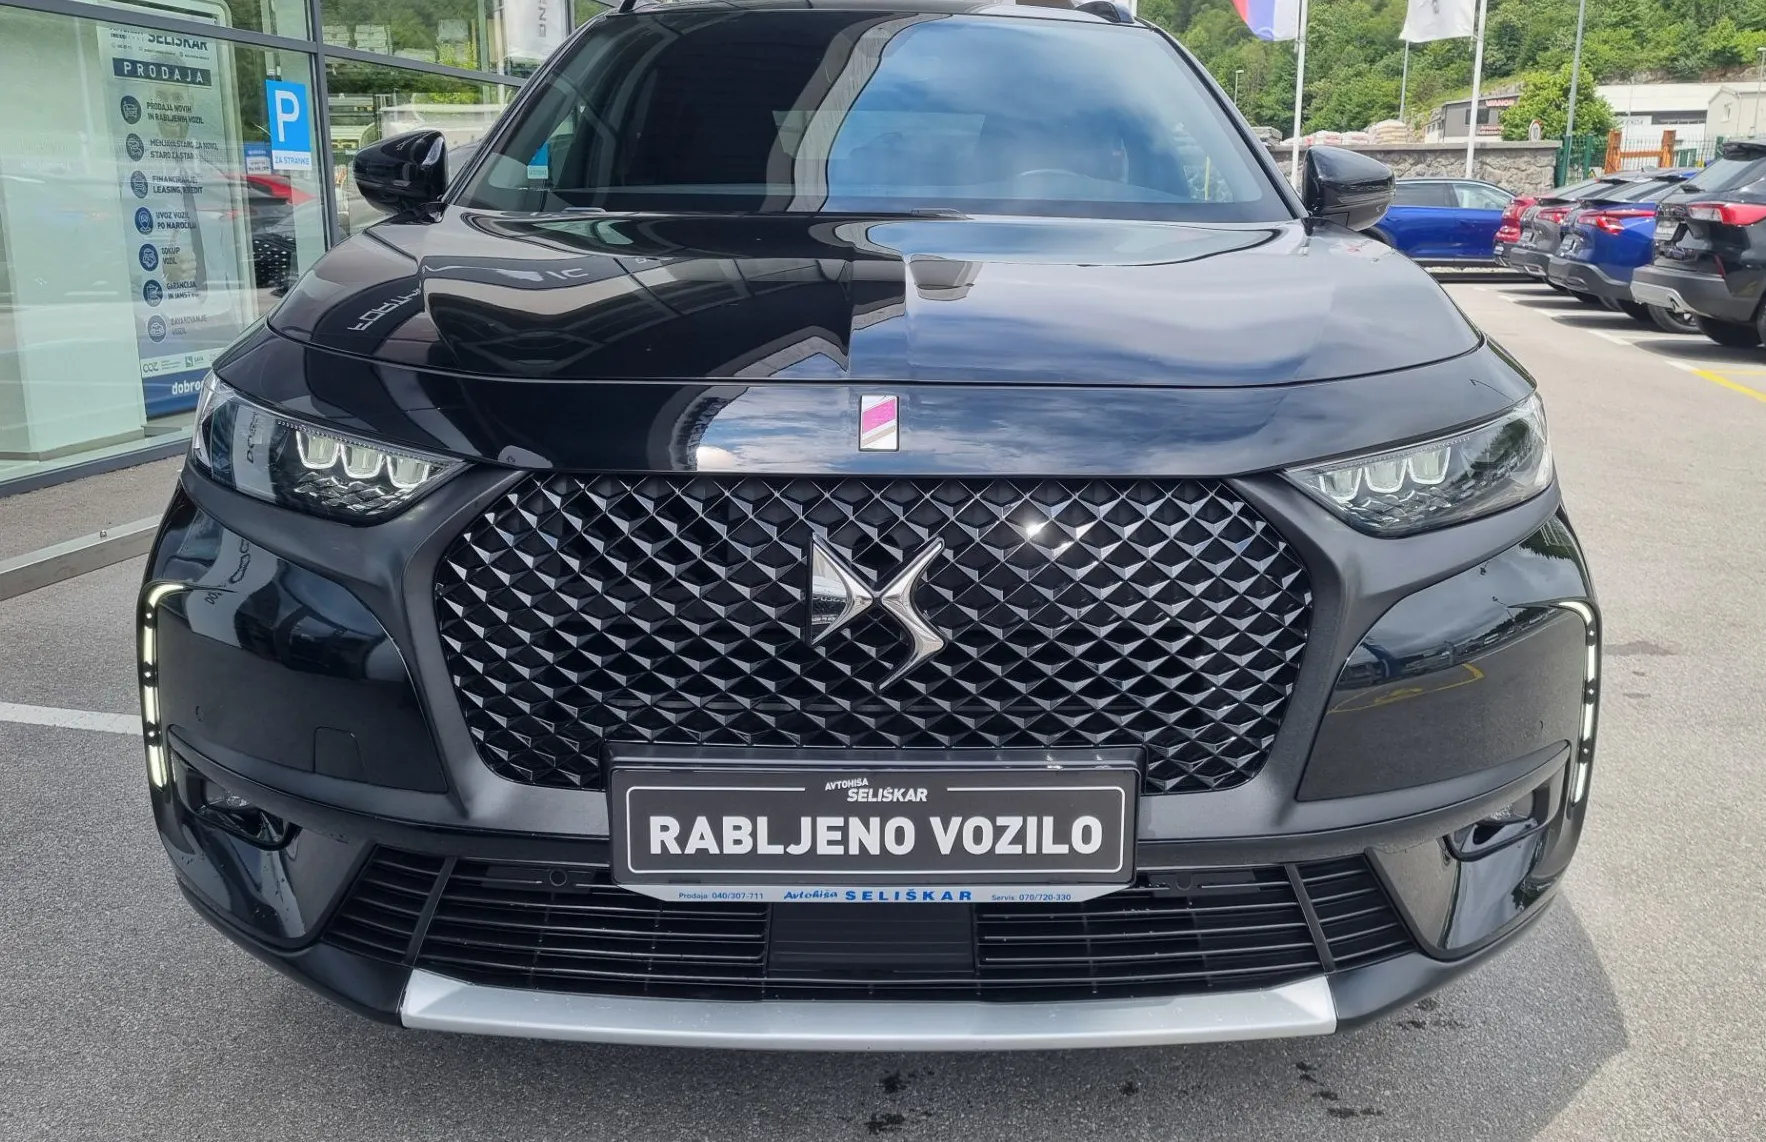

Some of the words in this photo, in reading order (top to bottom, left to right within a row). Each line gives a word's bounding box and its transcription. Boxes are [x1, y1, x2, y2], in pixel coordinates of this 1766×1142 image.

[123, 61, 204, 84] PRODAJA
[147, 101, 173, 112] PRODAJA
[174, 104, 192, 114] NOVIH
[155, 113, 188, 123] RABLJENIH
[188, 115, 204, 125] VOZIL
[274, 90, 300, 142] P
[150, 151, 171, 159] STARO
[275, 156, 283, 164] ZA
[284, 156, 310, 166] STRANKE
[153, 186, 183, 195] LEASING,
[183, 186, 203, 195] KREDIT
[156, 211, 172, 219] UVOZ
[173, 211, 190, 220] VOZIL
[161, 247, 180, 255] ODKUP
[163, 257, 178, 265] VOZIL
[166, 281, 197, 290] GARANCIJA
[825, 777, 869, 791] AVTOHIŠA
[847, 787, 928, 802] SELIŠKAR
[650, 816, 916, 855] RABLJENO
[929, 816, 1103, 855] VOZILO
[711, 892, 764, 900] 040/307-711
[783, 888, 838, 901] Avtohiša
[845, 888, 972, 901] SELIŠKAR
[1018, 893, 1072, 901] 070/720-330
